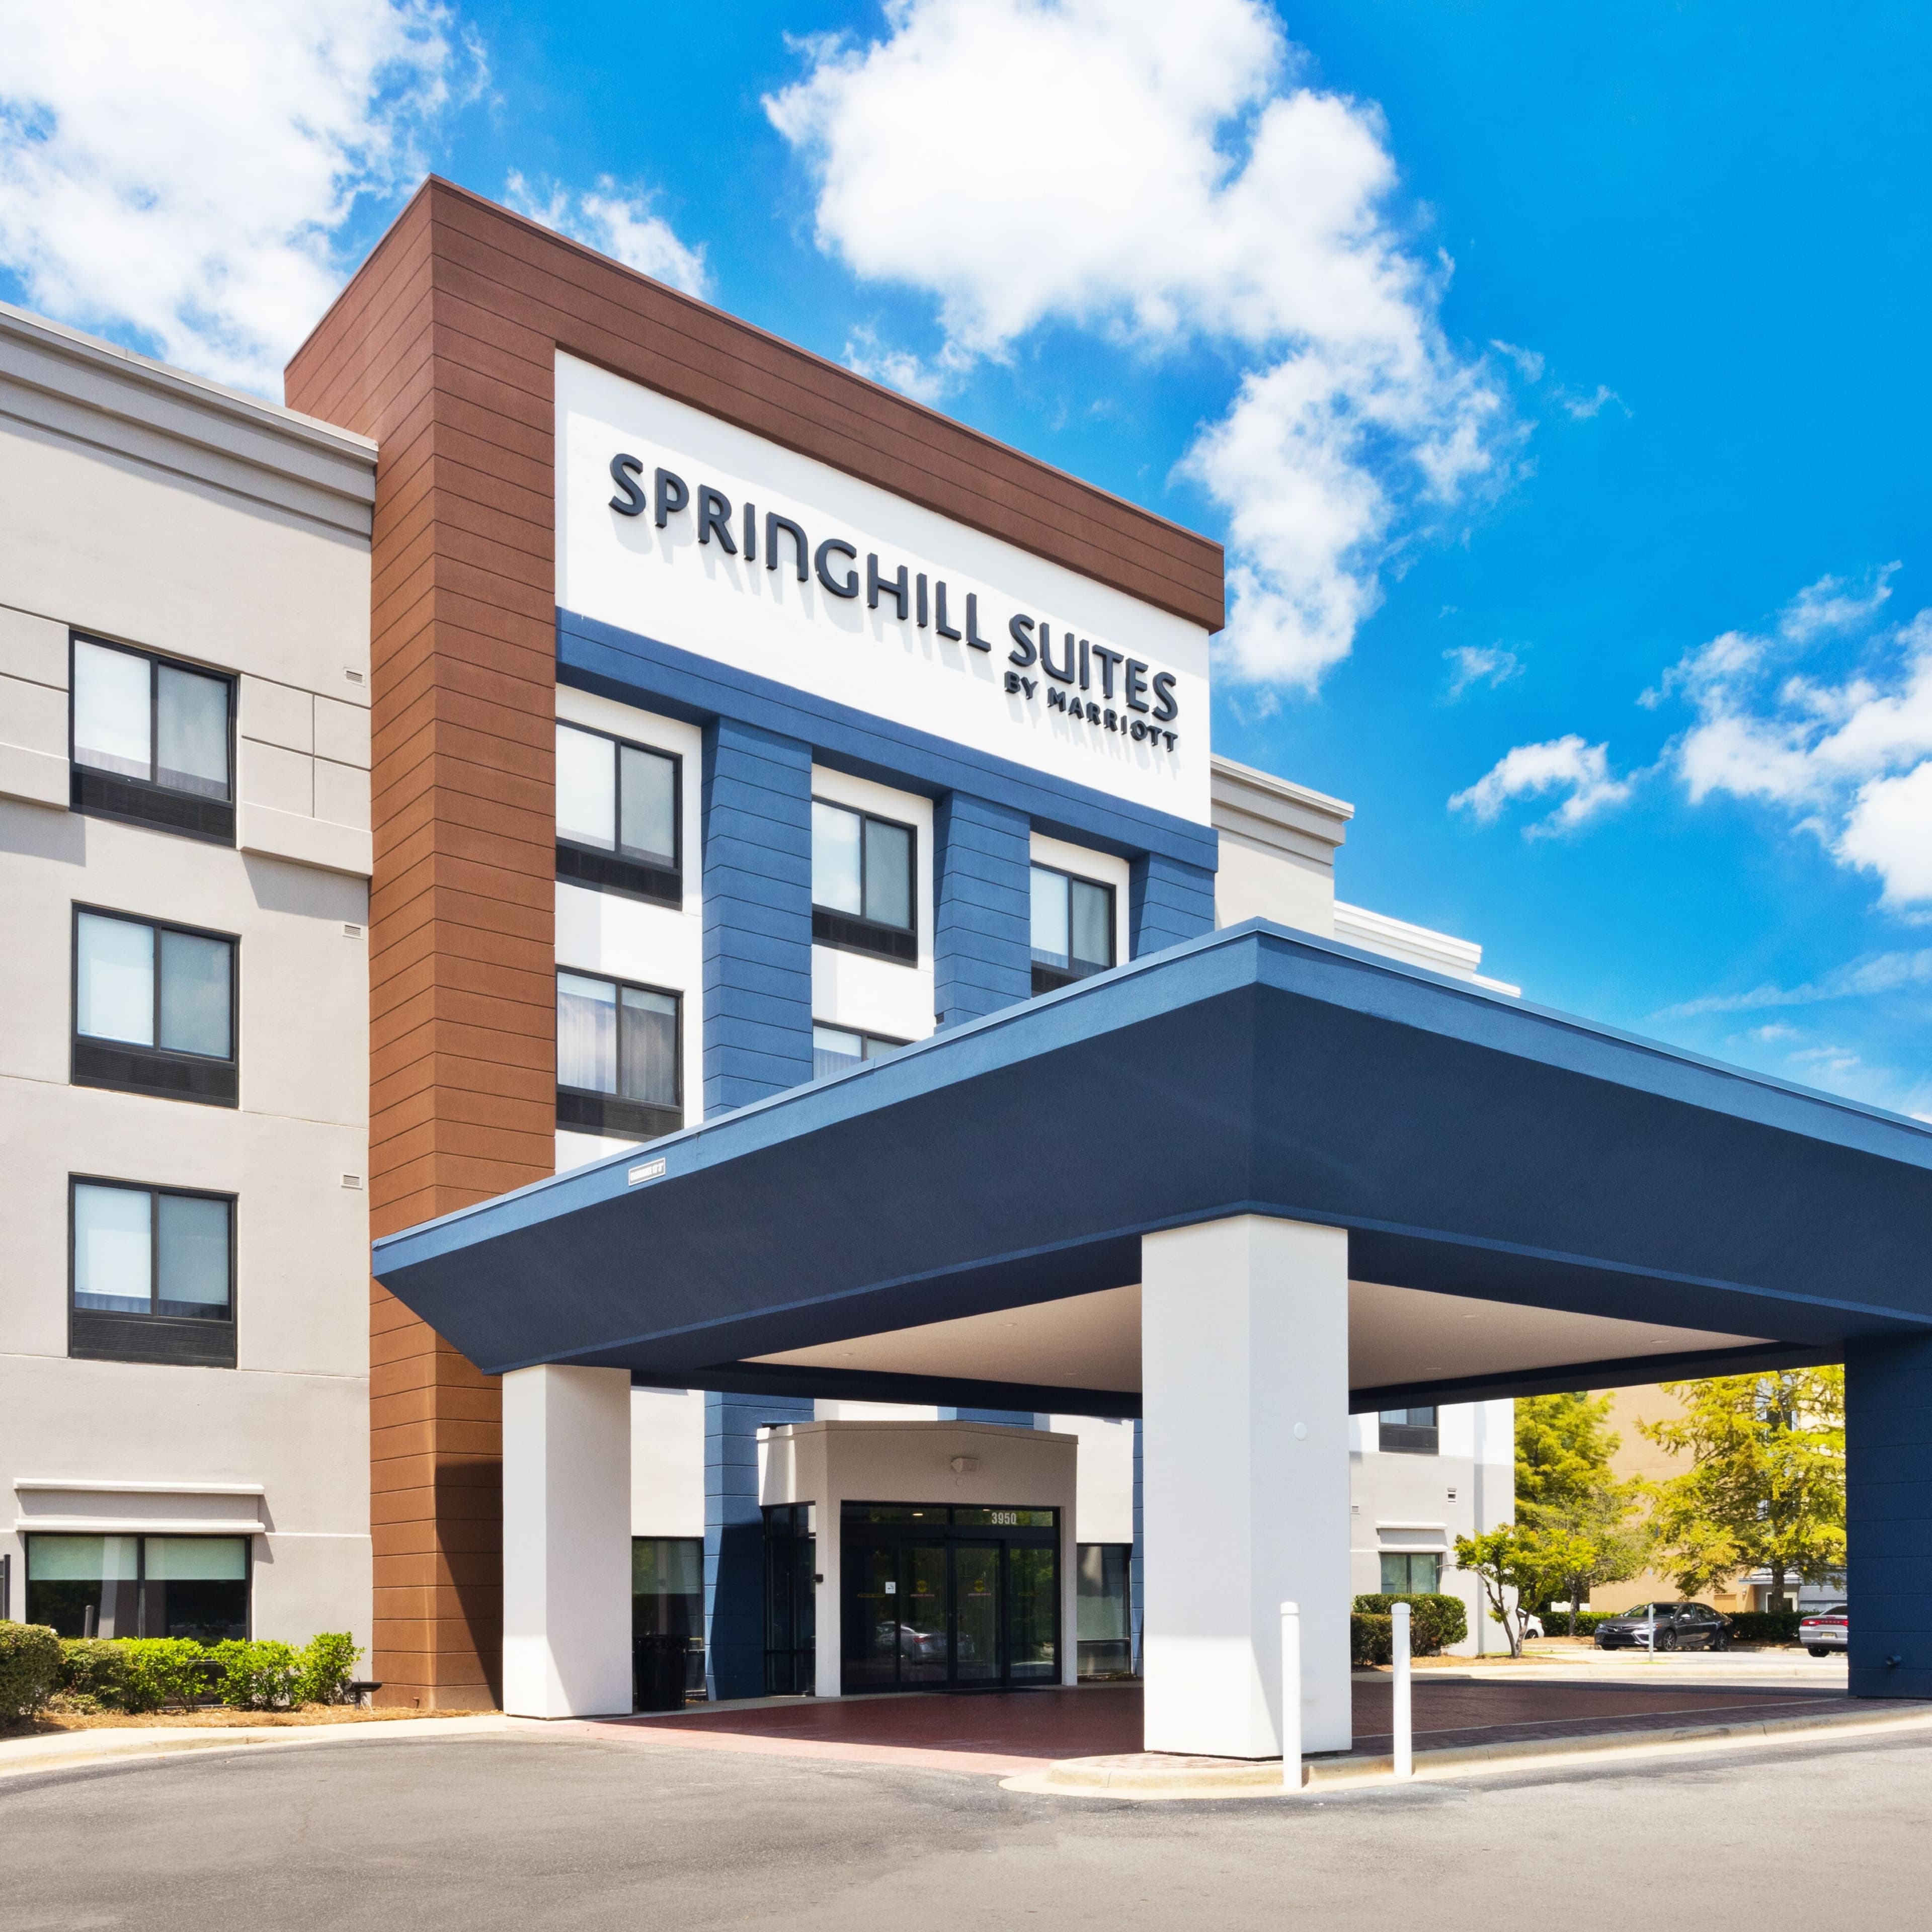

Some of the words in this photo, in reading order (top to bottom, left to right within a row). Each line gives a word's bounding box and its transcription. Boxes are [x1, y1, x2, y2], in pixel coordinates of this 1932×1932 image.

[609, 453, 991, 653] SPRINGHILL
[1008, 614, 1178, 721] SUITES
[1004, 671, 1039, 700] BY
[1047, 687, 1178, 752] MARRIOTT
[992, 1512, 1016, 1524] 3950
